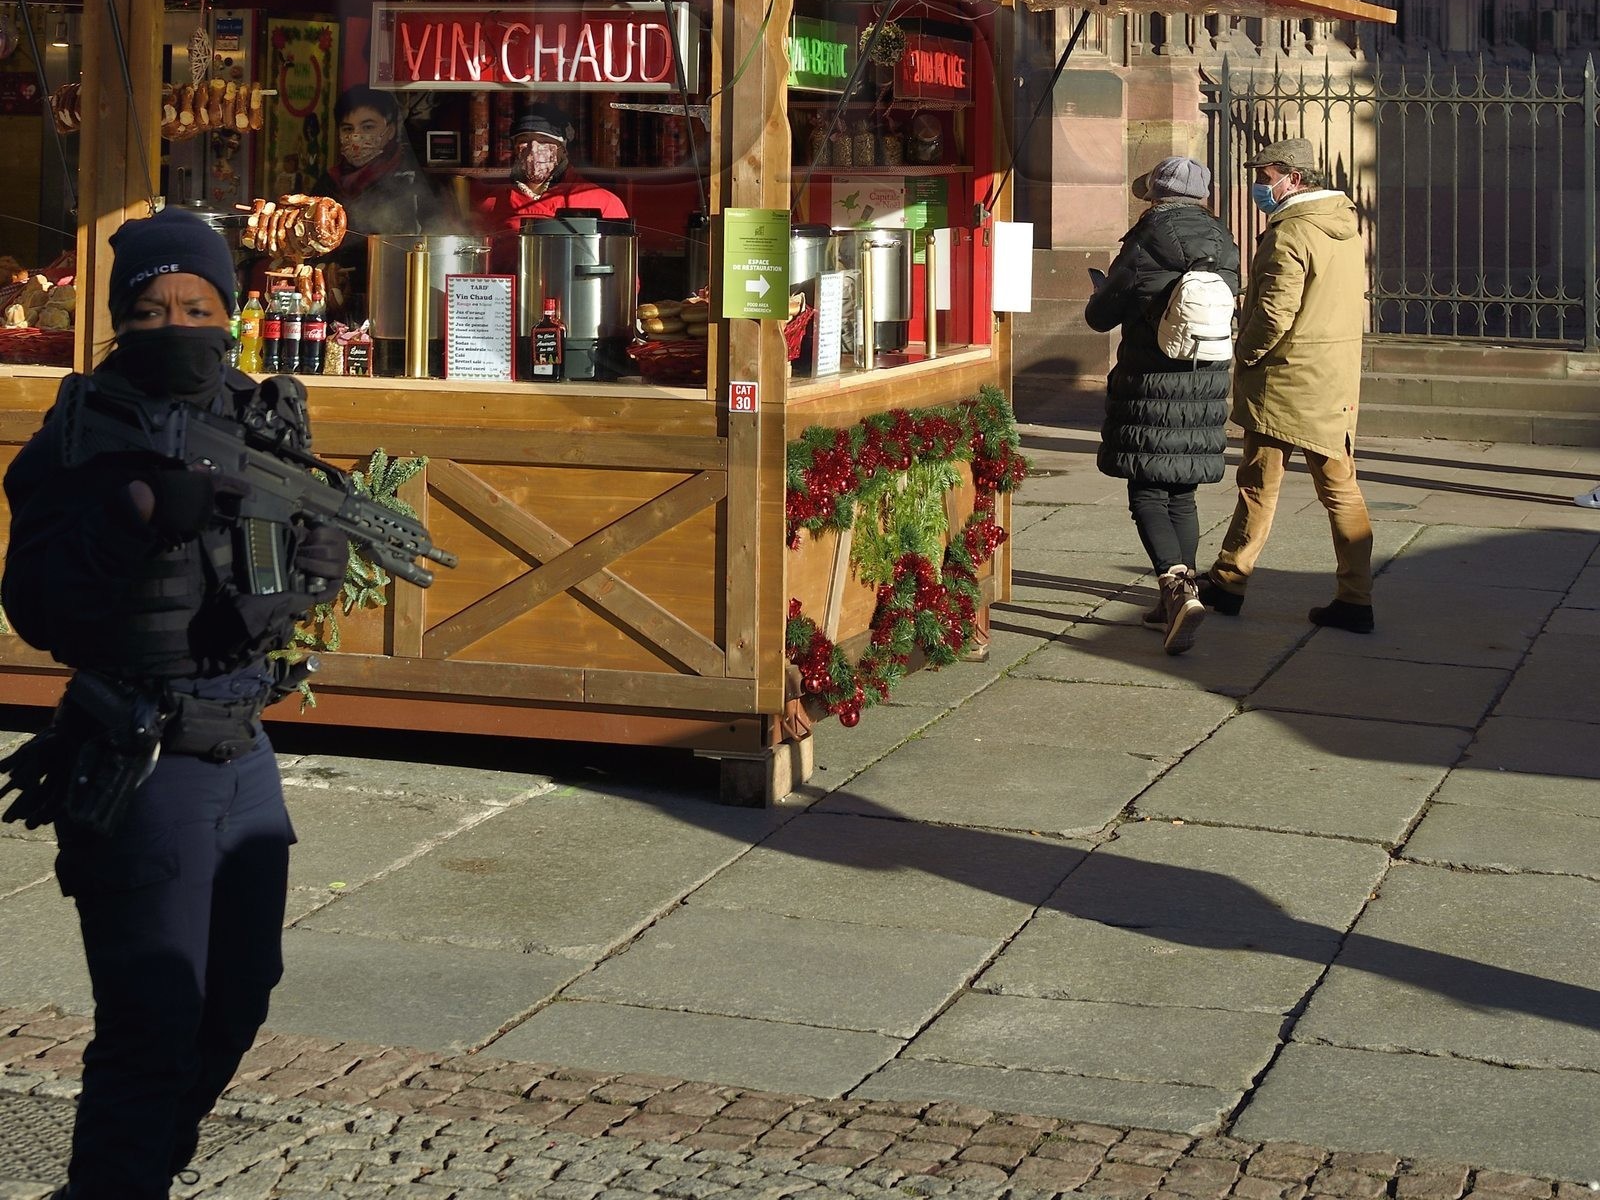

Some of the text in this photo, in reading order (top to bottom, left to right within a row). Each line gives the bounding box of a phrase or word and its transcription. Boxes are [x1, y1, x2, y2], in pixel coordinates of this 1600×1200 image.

[401, 22, 672, 83] VIN CHAUD
[129, 263, 180, 287] POLICE
[741, 264, 782, 272] RESTAURATION
[735, 385, 752, 395] CAT
[735, 396, 751, 410] 30
